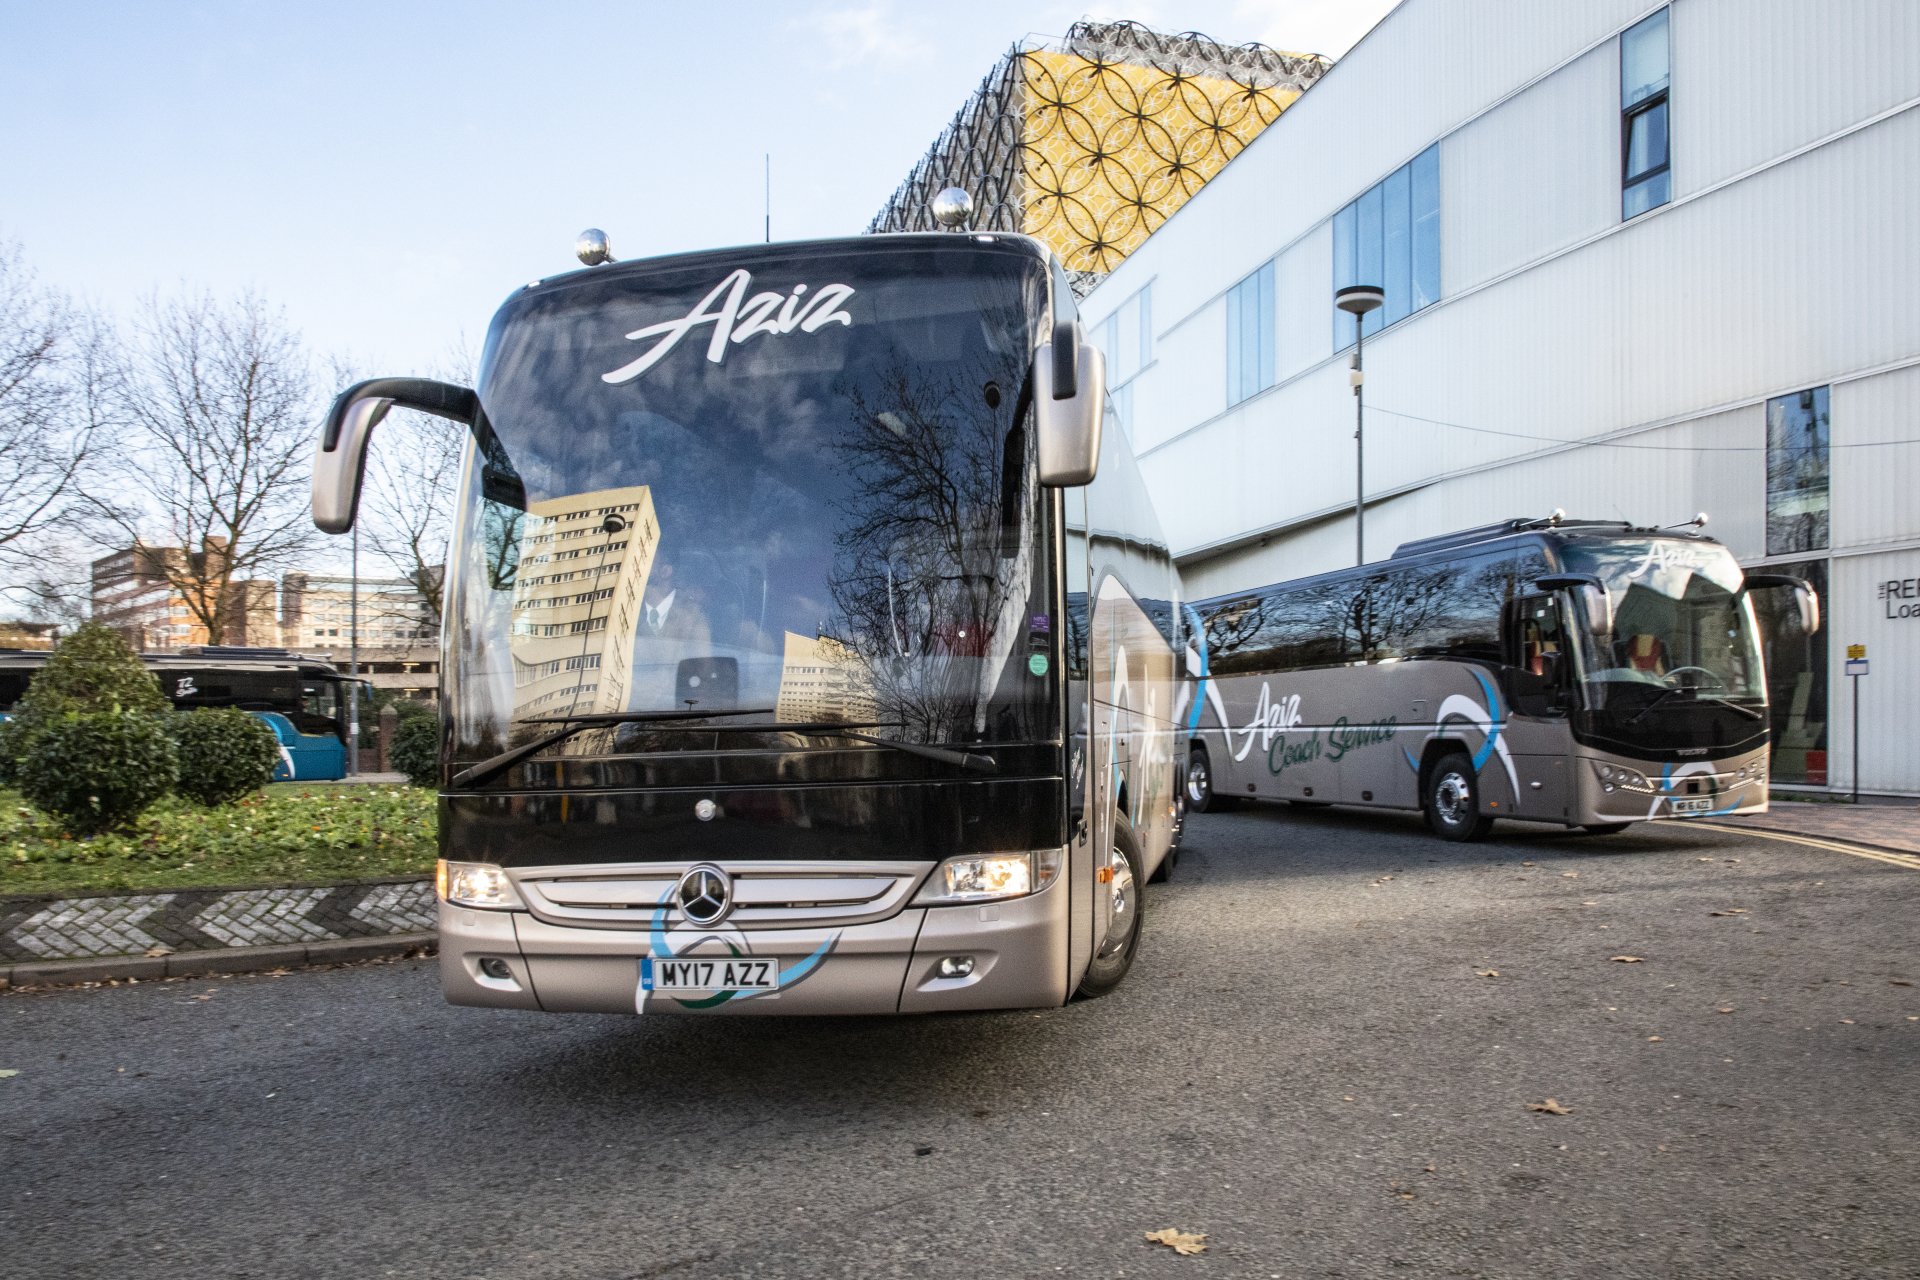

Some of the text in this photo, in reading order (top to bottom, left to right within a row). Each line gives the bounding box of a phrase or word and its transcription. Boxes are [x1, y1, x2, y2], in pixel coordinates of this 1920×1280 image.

[600, 269, 855, 384] Aziz
[1886, 578, 1920, 600] RE
[1234, 681, 1302, 762] Aziz
[1268, 715, 1397, 776] Coach Service
[661, 962, 770, 986] MY17 AZZ
